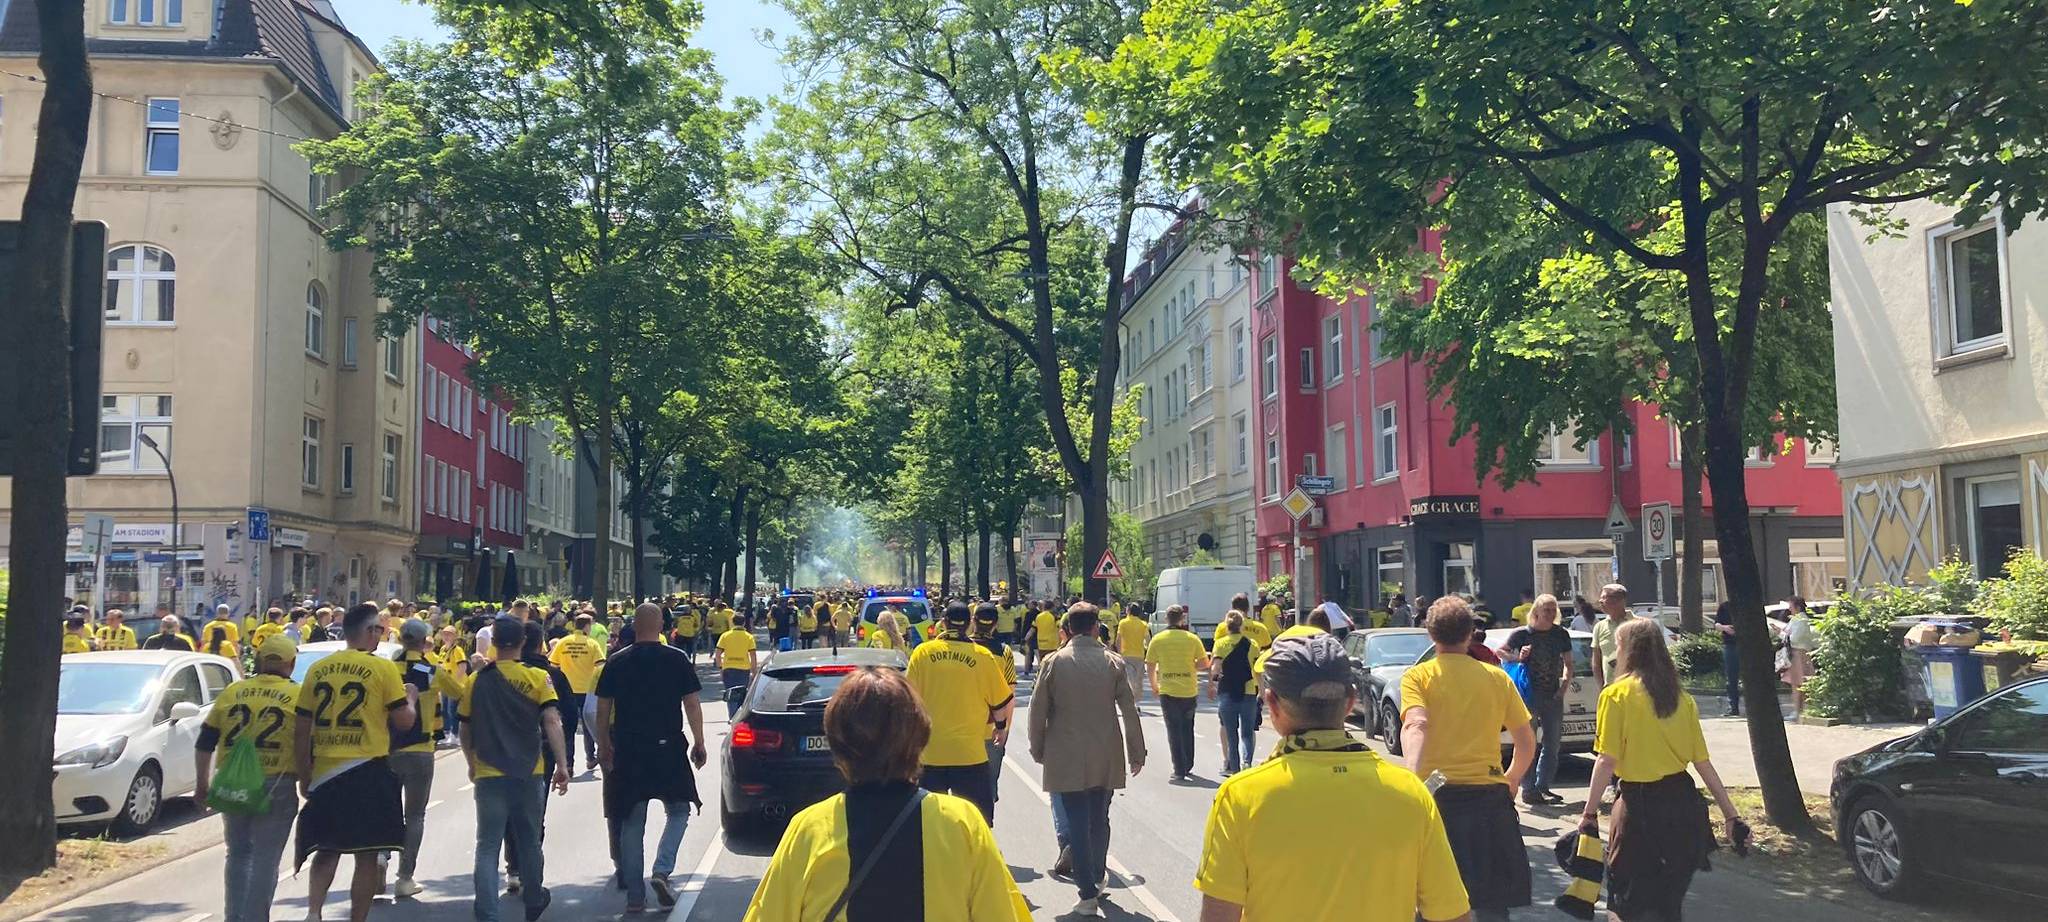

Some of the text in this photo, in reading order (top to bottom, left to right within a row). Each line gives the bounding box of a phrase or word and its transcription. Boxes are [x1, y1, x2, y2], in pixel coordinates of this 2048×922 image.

[1430, 502, 1479, 513] GRACE
[930, 651, 977, 668] DORTMUND
[314, 663, 372, 681] DORTMUND
[235, 687, 292, 704] DORTMUND
[313, 681, 367, 728] 22
[223, 703, 286, 749] 22
[808, 737, 823, 749] DO
